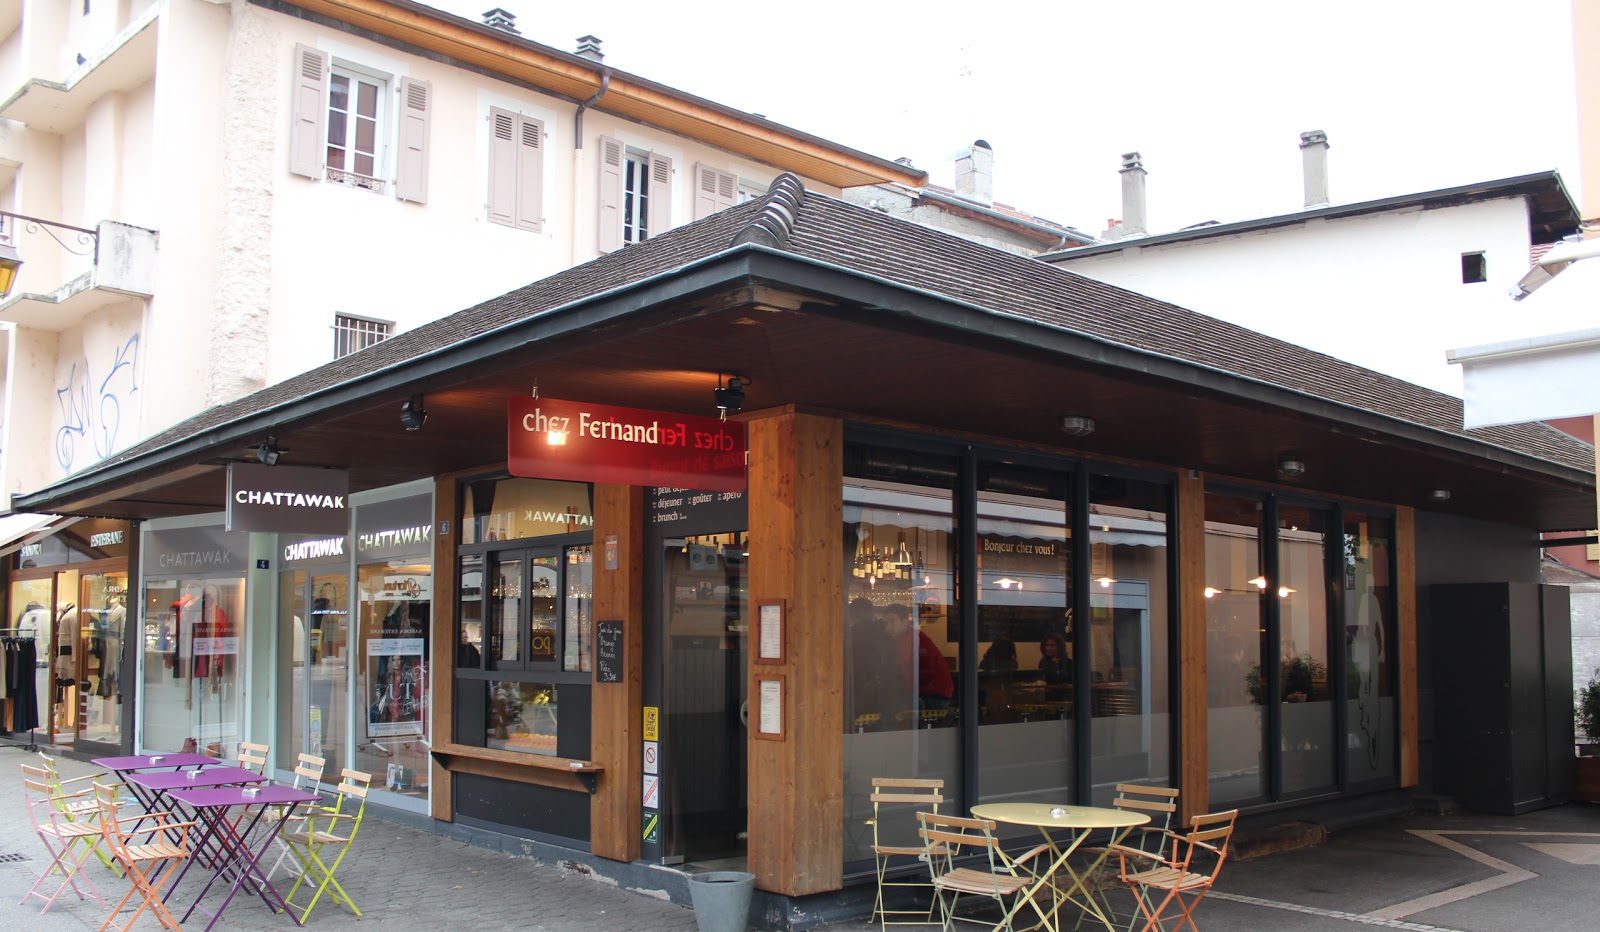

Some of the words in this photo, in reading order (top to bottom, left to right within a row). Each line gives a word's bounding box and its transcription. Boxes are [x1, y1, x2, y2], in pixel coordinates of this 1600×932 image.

[522, 408, 570, 434] chez
[579, 412, 659, 444] Fernand
[235, 489, 345, 509] CHATTAWAK
[657, 498, 683, 510] déjeuner
[692, 493, 713, 506] goûter
[657, 511, 679, 523] brunch
[90, 530, 124, 548] ESTEBANE
[357, 524, 432, 552] CHATTAWAK
[984, 539, 1015, 555] Bonjour
[1016, 542, 1033, 554] chez
[21, 543, 44, 557] SANDRA
[159, 549, 231, 568] CHATTAWAK
[284, 537, 344, 562] CHATTAWAK
